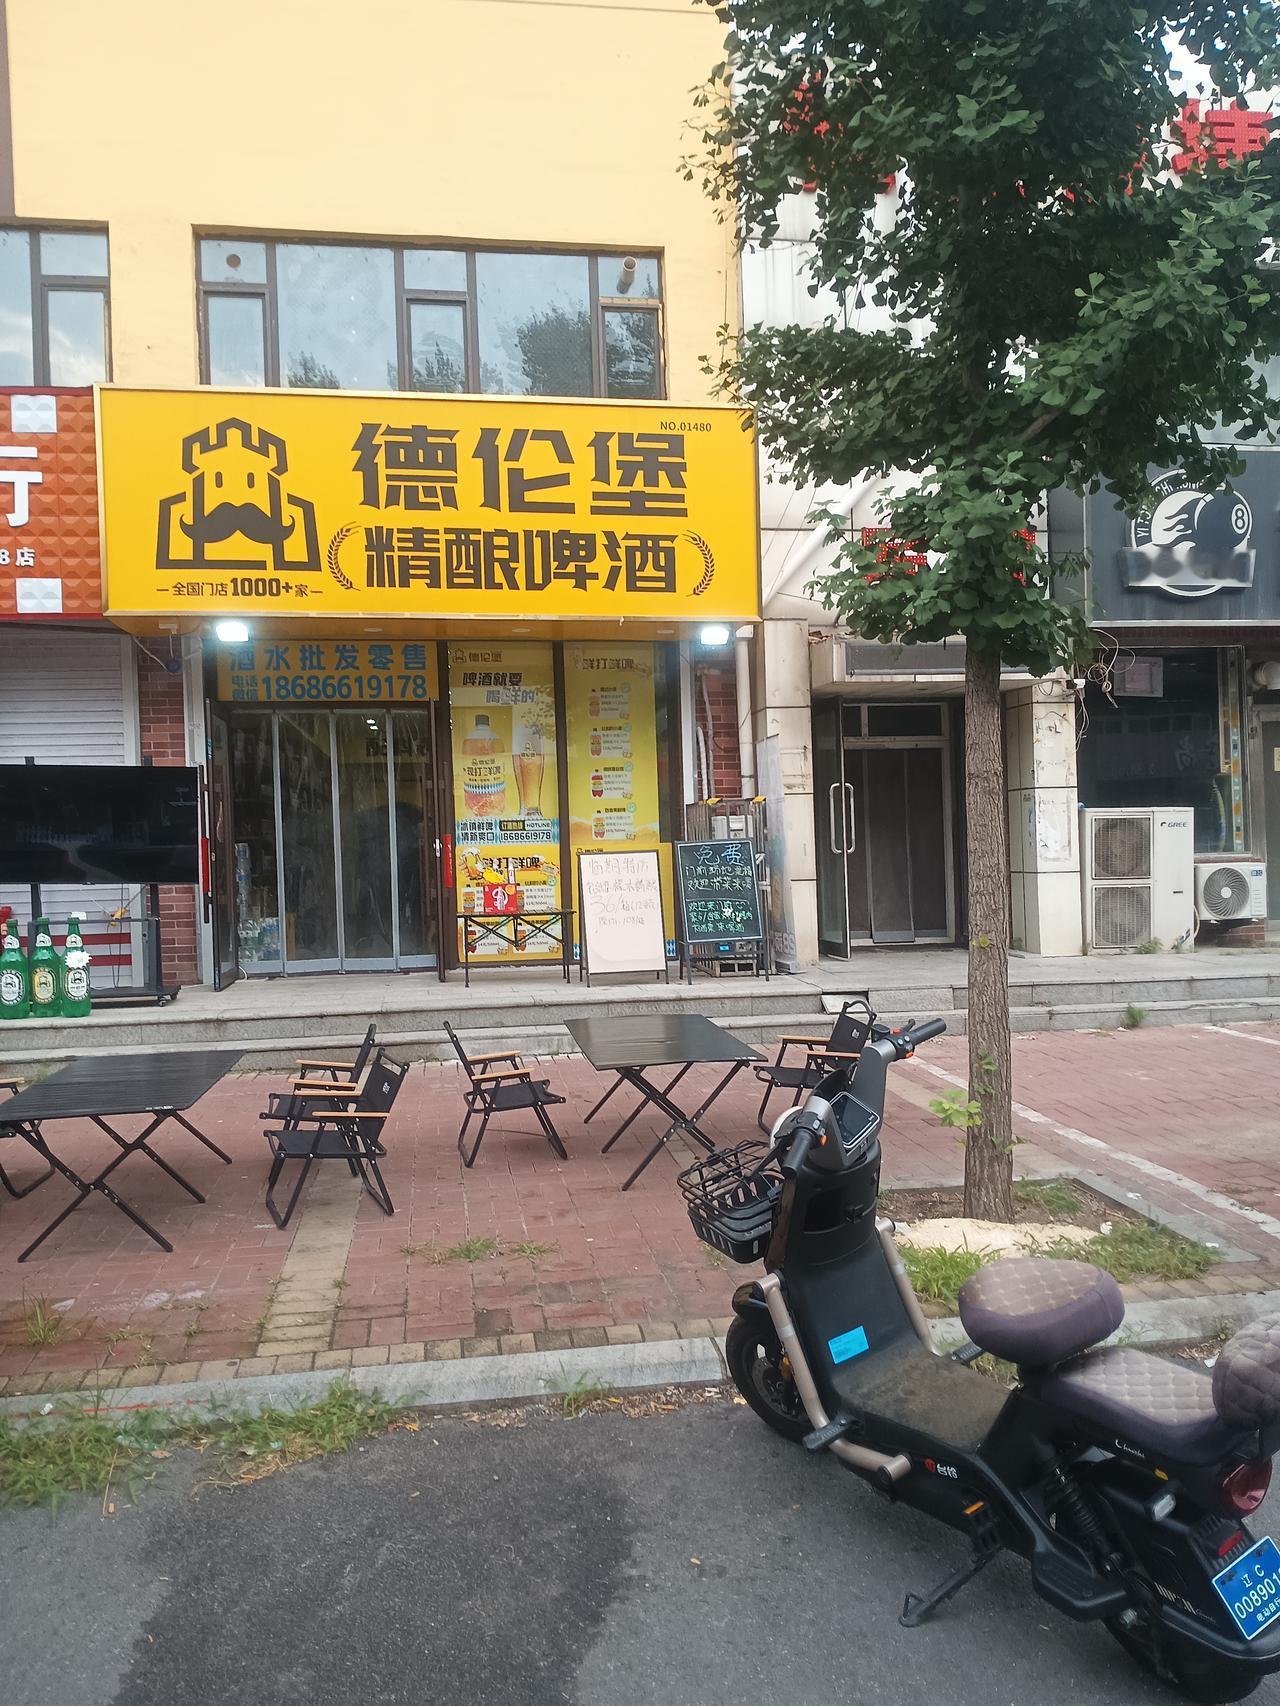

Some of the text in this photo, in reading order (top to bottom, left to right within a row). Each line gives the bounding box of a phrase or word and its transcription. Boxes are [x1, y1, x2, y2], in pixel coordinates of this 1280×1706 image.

[659, 420, 712, 432] NO.01480
[351, 423, 688, 518] 德伦堡
[1234, 507, 1246, 531] 8
[364, 525, 678, 593] 精酿啤酒
[229, 644, 427, 672] 酒水批发零售
[262, 674, 427, 699] 18686619178
[462, 672, 523, 686] 啤酒就要
[500, 832, 551, 841] 18686619178
[693, 844, 744, 866] 免费
[1254, 1564, 1264, 1577] C
